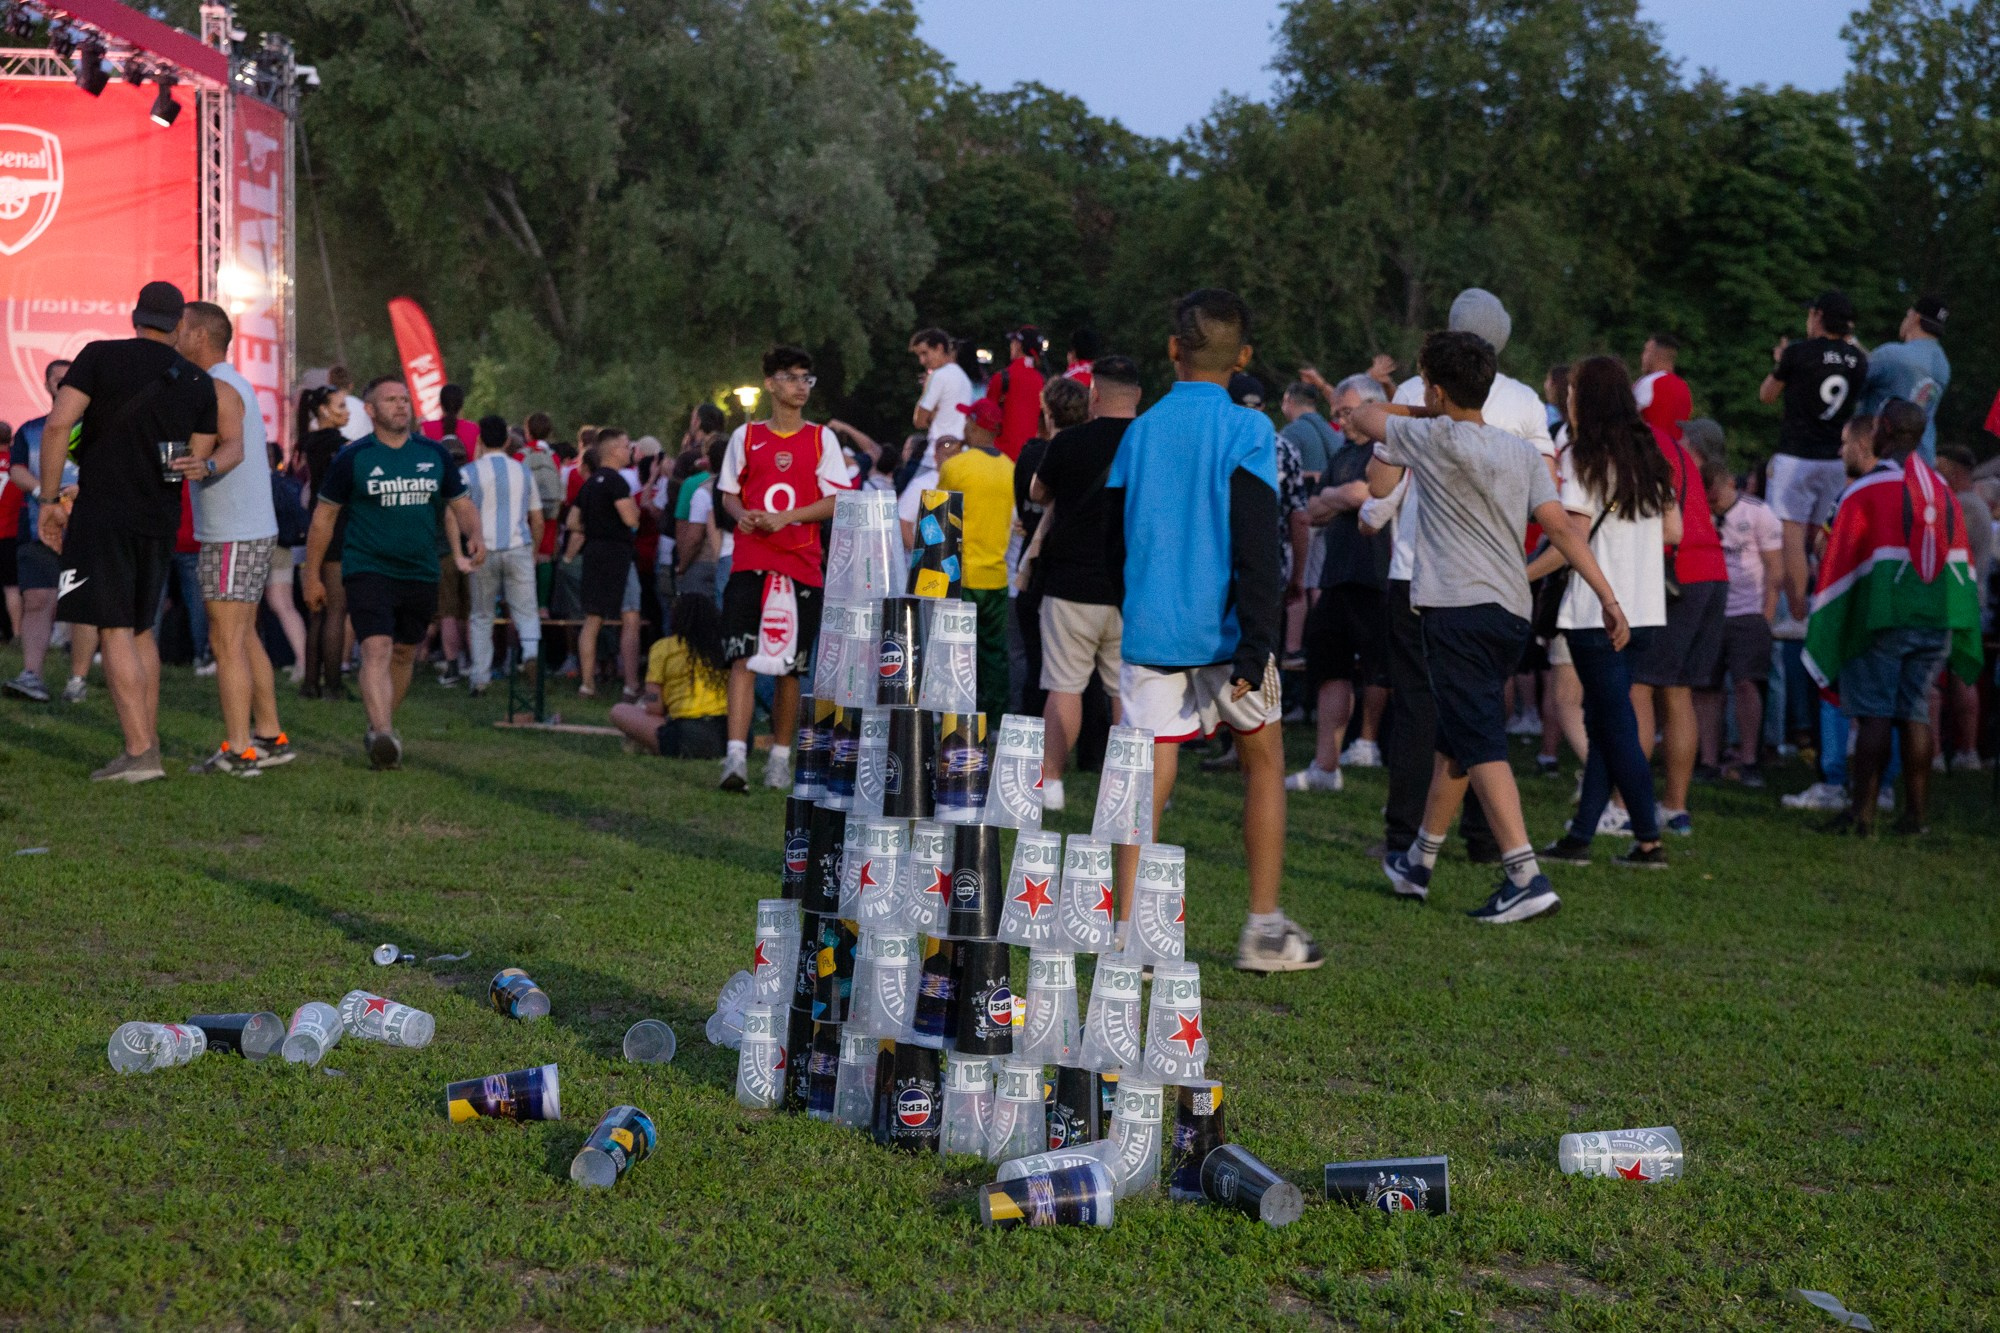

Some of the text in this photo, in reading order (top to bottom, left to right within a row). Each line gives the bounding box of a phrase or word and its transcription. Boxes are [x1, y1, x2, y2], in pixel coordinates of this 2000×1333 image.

[1819, 374, 1848, 420] 9
[367, 476, 438, 495] Emirates
[381, 493, 397, 507] FLY
[943, 615, 976, 635] en
[788, 851, 807, 859] EPSI
[1139, 899, 1181, 956] QUALITY
[342, 992, 363, 1025] MALT
[899, 1103, 930, 1111] PEPSI
